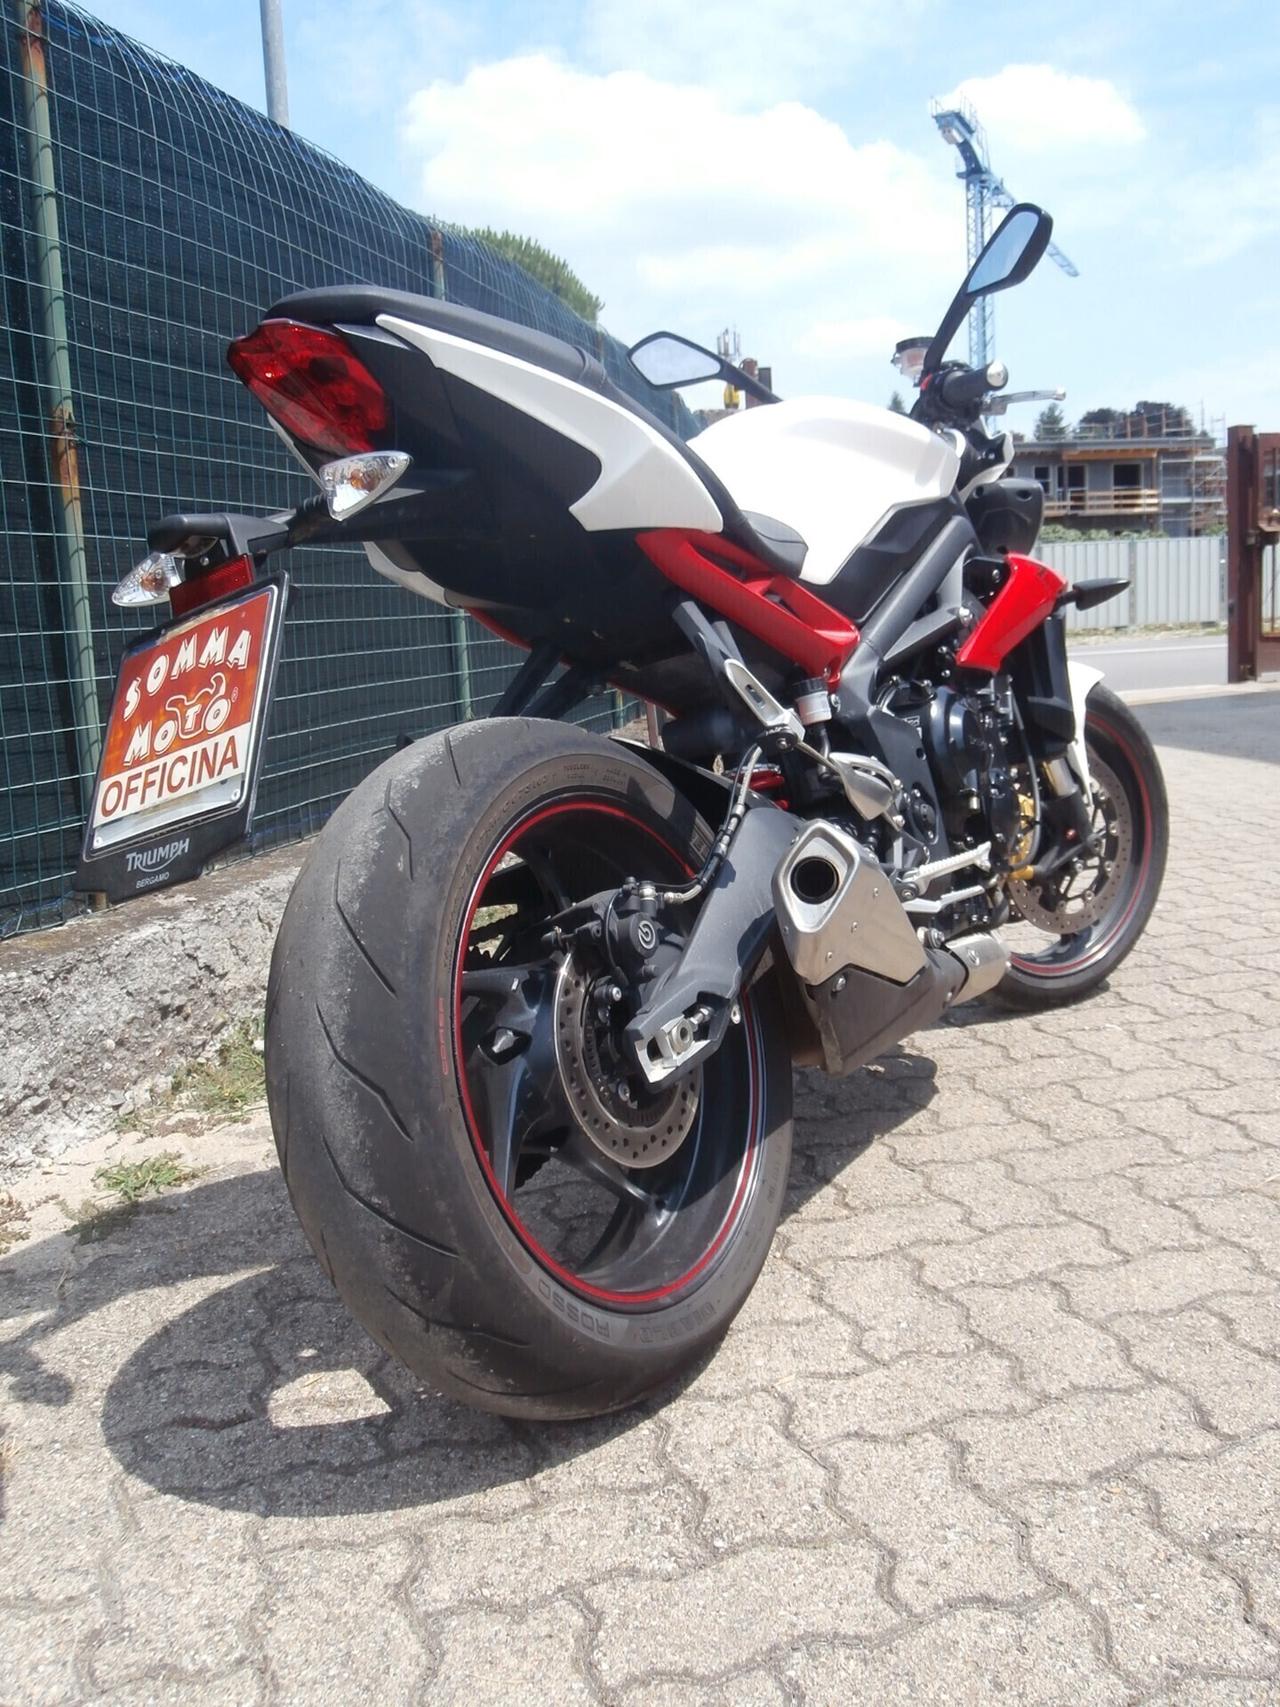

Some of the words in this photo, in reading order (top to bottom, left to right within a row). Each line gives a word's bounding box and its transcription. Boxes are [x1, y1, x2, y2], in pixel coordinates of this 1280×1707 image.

[124, 626, 251, 721] SOMMA
[101, 735, 239, 818] OFFICINA
[126, 838, 190, 873] TRIUMPH
[136, 872, 170, 889] BERGAMO
